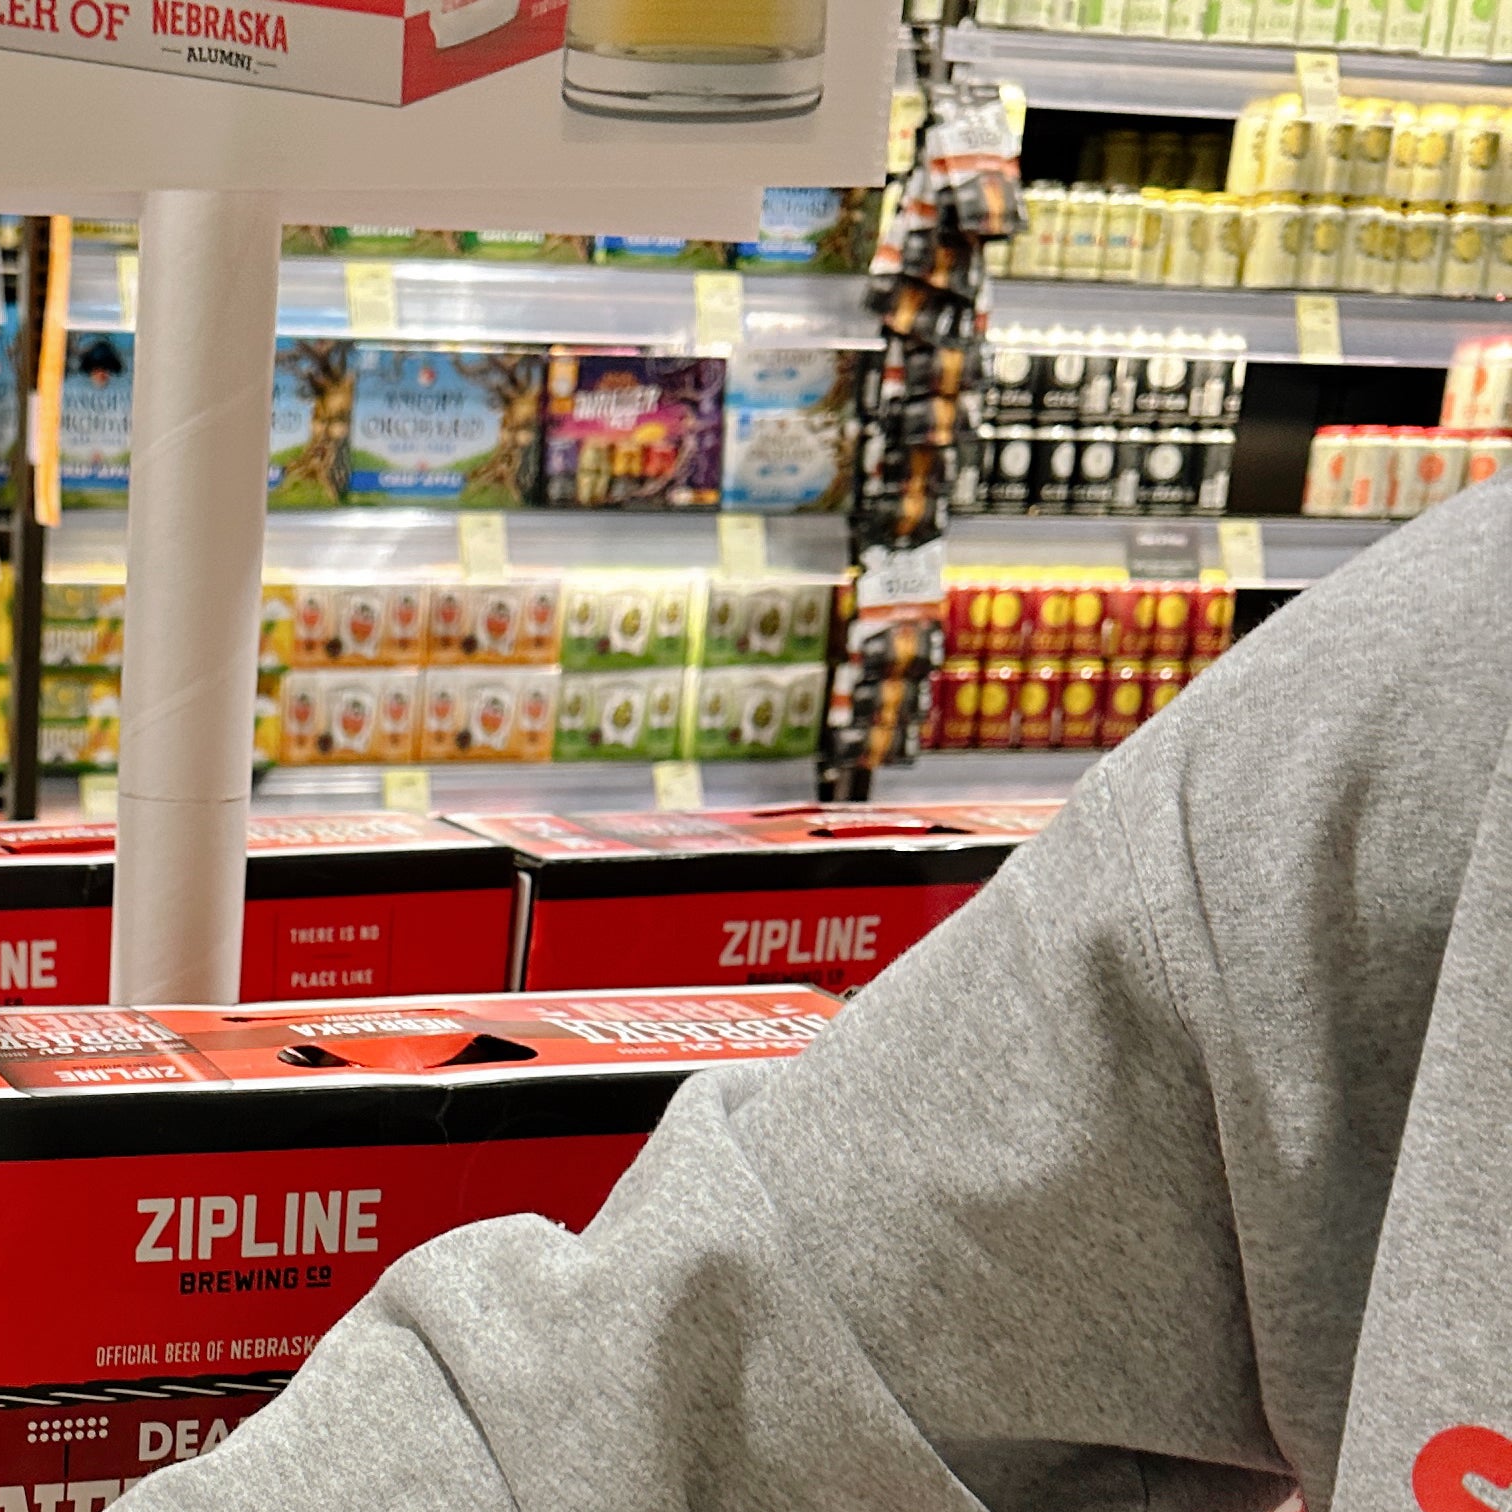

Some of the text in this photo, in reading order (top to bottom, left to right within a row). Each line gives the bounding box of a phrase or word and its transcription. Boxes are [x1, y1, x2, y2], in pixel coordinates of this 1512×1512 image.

[70, 1, 131, 41] OF
[152, 0, 289, 54] NEBRASKA
[186, 47, 254, 71] ALUMNI
[290, 924, 381, 945] THERE NO
[719, 915, 881, 967] ZIPLINE
[290, 968, 374, 989] PLACE LIKE
[54, 1064, 185, 1084] ZIPLINE
[134, 1187, 382, 1264] ZIPLINE
[178, 1267, 300, 1297] BREWING
[95, 1335, 323, 1368] OFFICIAL BEER OF NEBRASK
